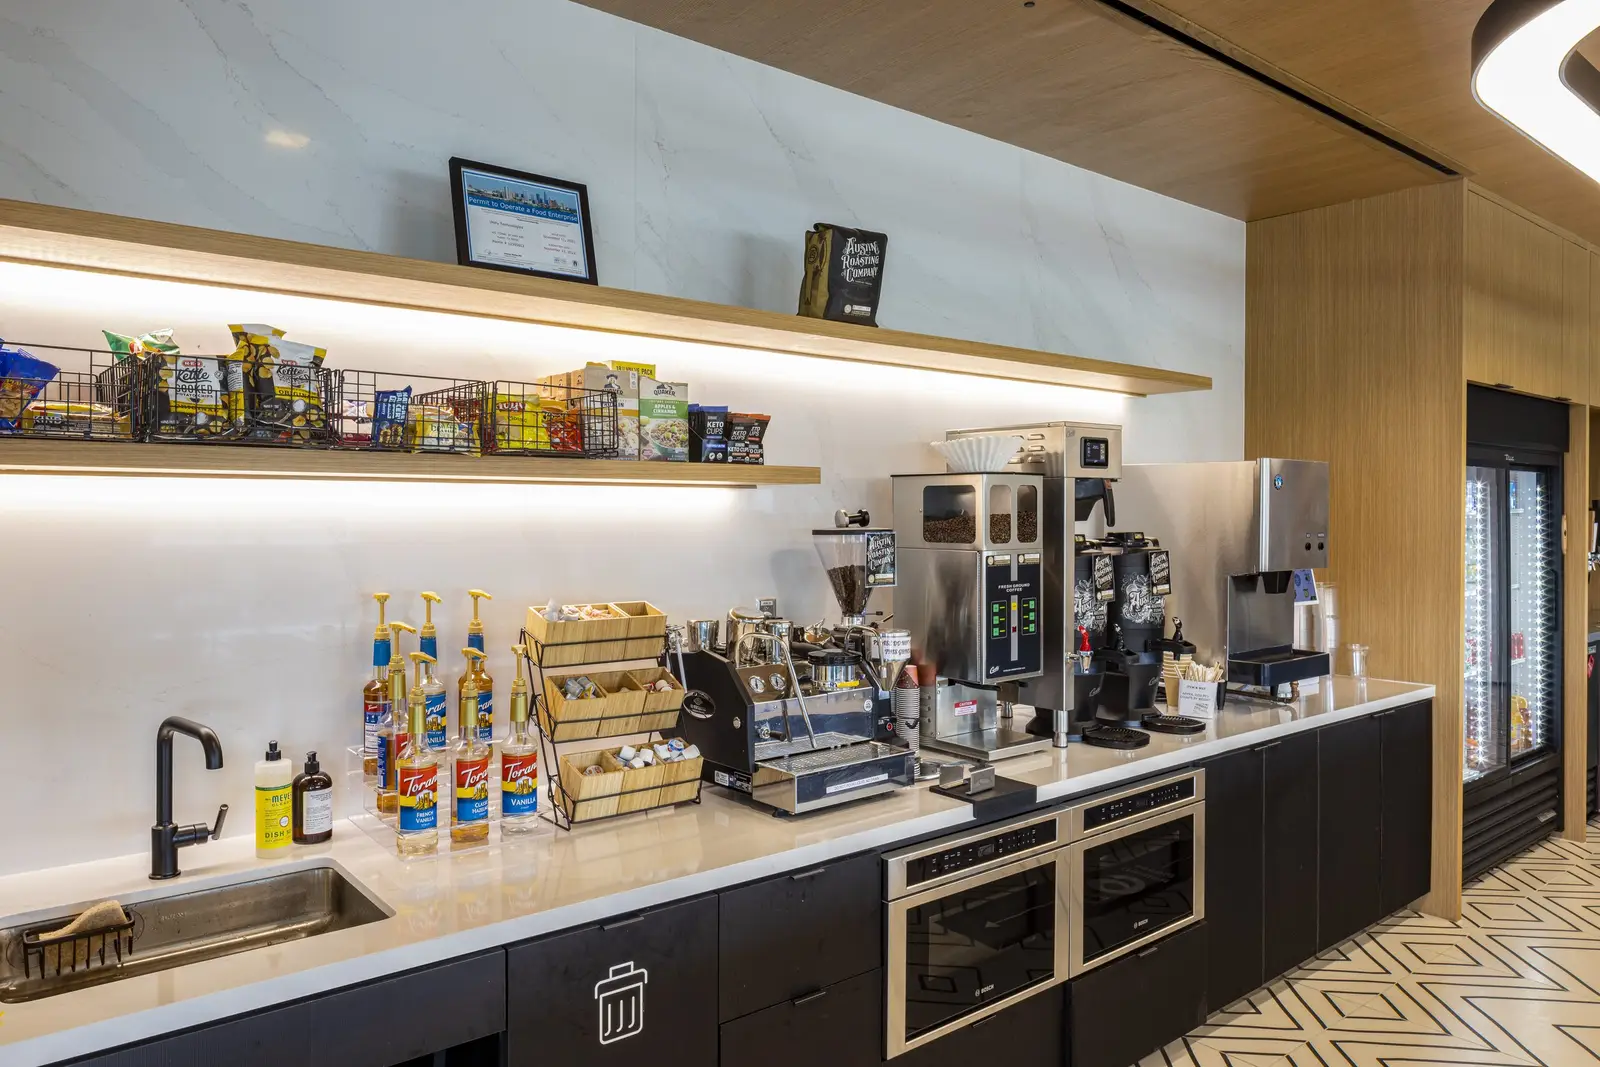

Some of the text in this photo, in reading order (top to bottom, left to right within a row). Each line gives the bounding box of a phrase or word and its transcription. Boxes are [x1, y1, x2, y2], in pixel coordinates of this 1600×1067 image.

[468, 196, 490, 206] Permit
[500, 202, 525, 212] Operate
[532, 207, 546, 216] Food
[548, 212, 578, 222] Enterprise
[843, 237, 879, 255] AUSTIN
[841, 254, 880, 269] ROASTING
[841, 267, 878, 282] COMPANY
[176, 367, 212, 383] Kettle
[427, 736, 444, 744] ANILLA
[461, 766, 488, 790] Tora
[504, 761, 537, 783] Toran
[404, 774, 438, 797] Toran
[511, 796, 536, 806] VANILLA
[264, 830, 284, 838] DISH
[980, 984, 994, 994] BOSCH
